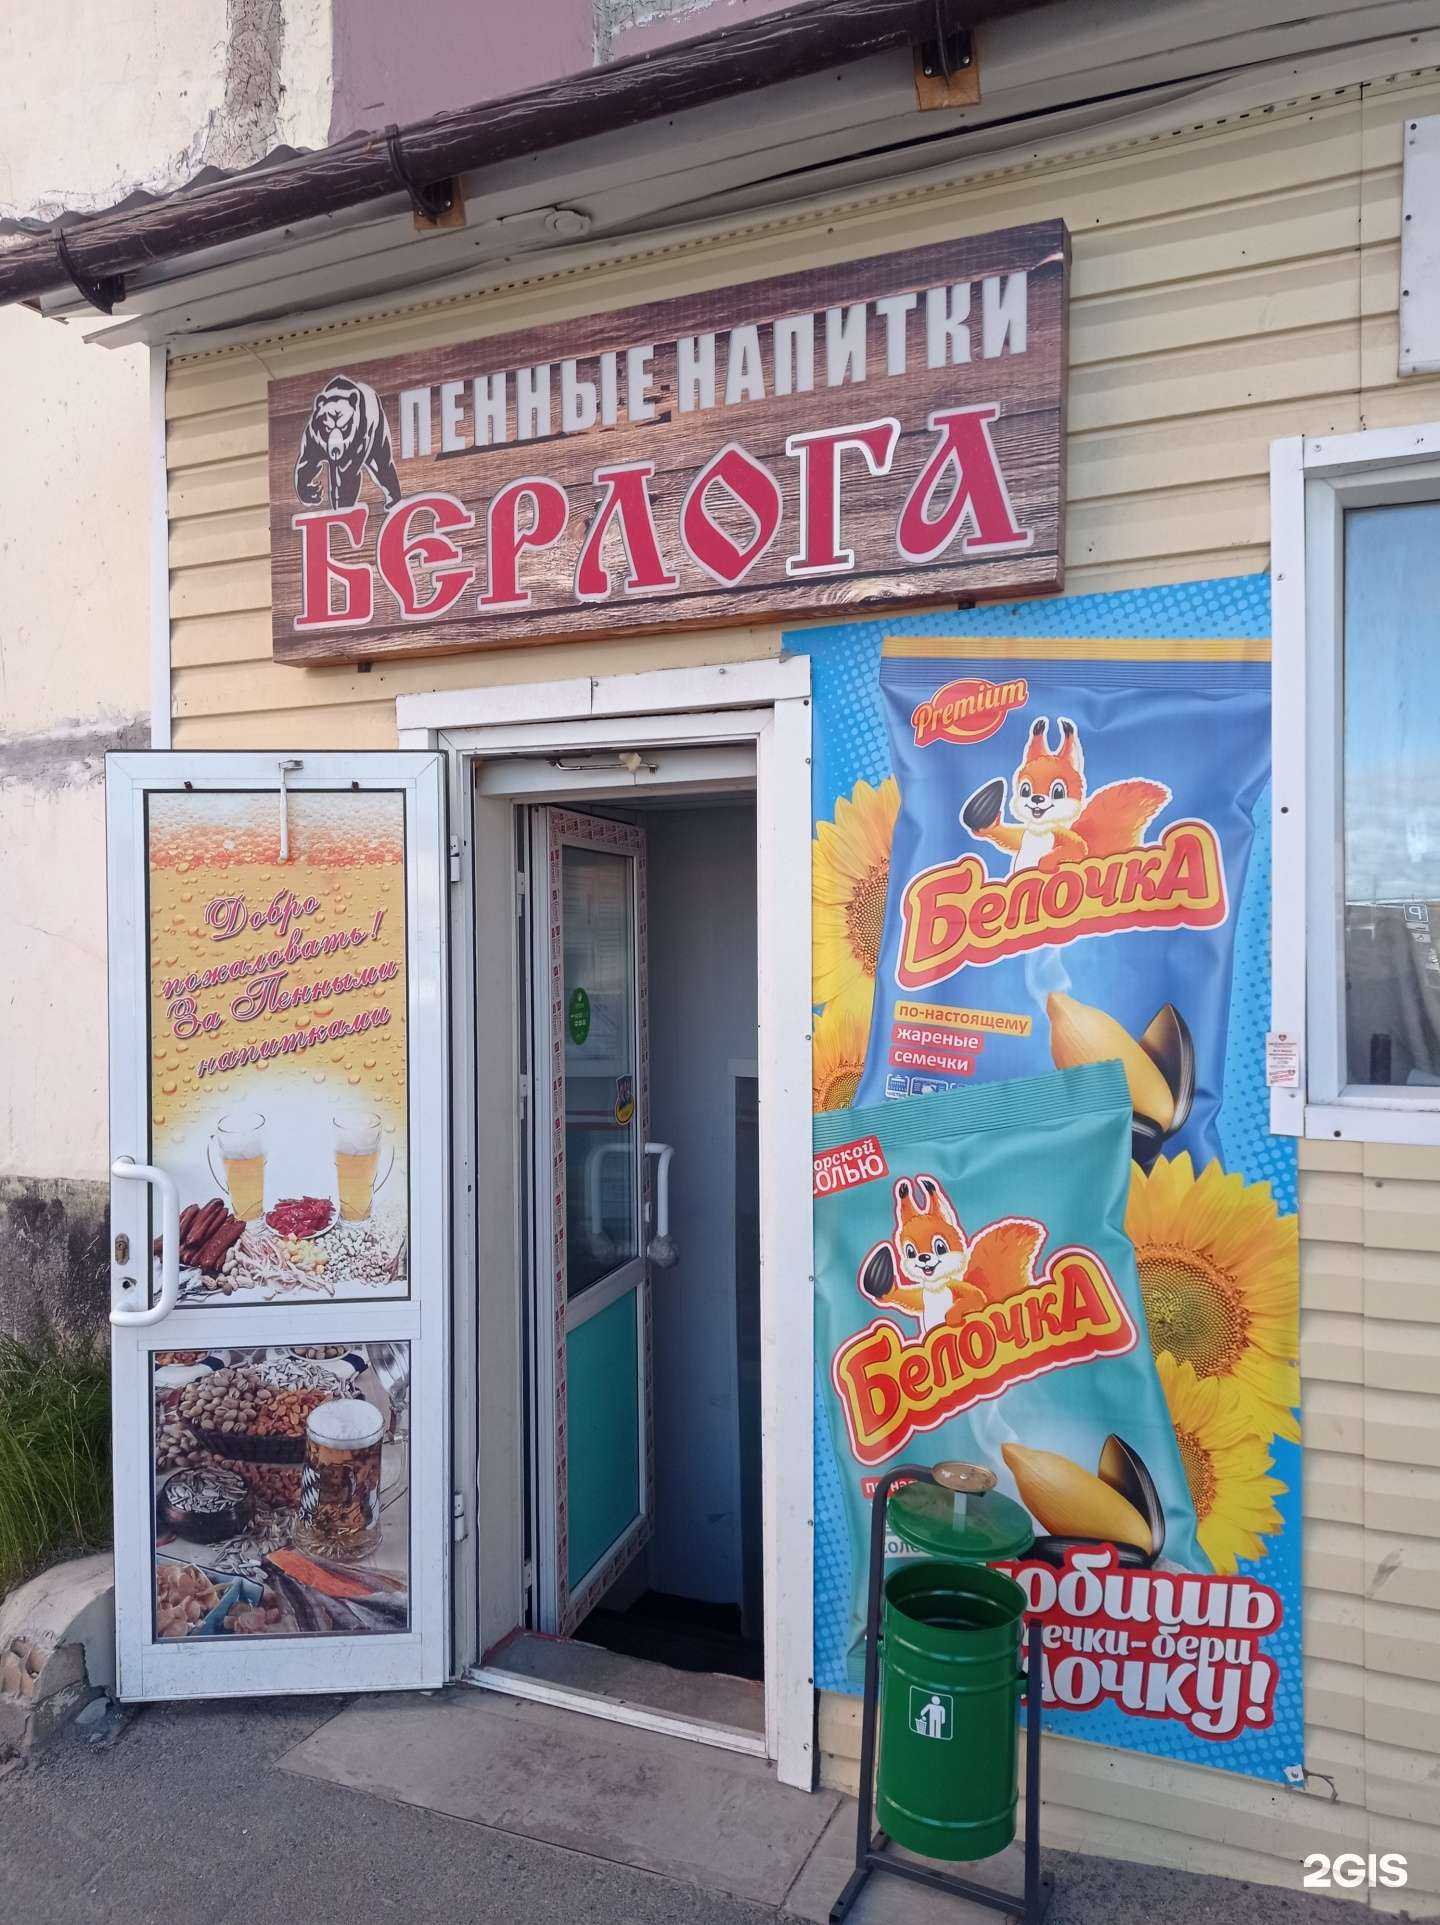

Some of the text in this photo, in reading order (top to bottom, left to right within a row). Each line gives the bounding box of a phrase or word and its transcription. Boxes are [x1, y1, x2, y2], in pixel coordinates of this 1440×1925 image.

[400, 270, 1029, 459] ПЕННЫЕ НАПИТКИ
[292, 402, 1035, 631] БЕРЛОГА
[914, 679, 1027, 738] Premium
[205, 887, 320, 941] Добро
[162, 910, 385, 999] пожаловать!
[168, 960, 399, 1039] За Пенными
[899, 1005, 1029, 1035] по-настоящему
[196, 1004, 392, 1078] напитками
[894, 1050, 969, 1072] семечки
[896, 1027, 979, 1049] жареные
[813, 1138, 876, 1171] орской
[813, 1154, 884, 1194] ОЛЬЮ
